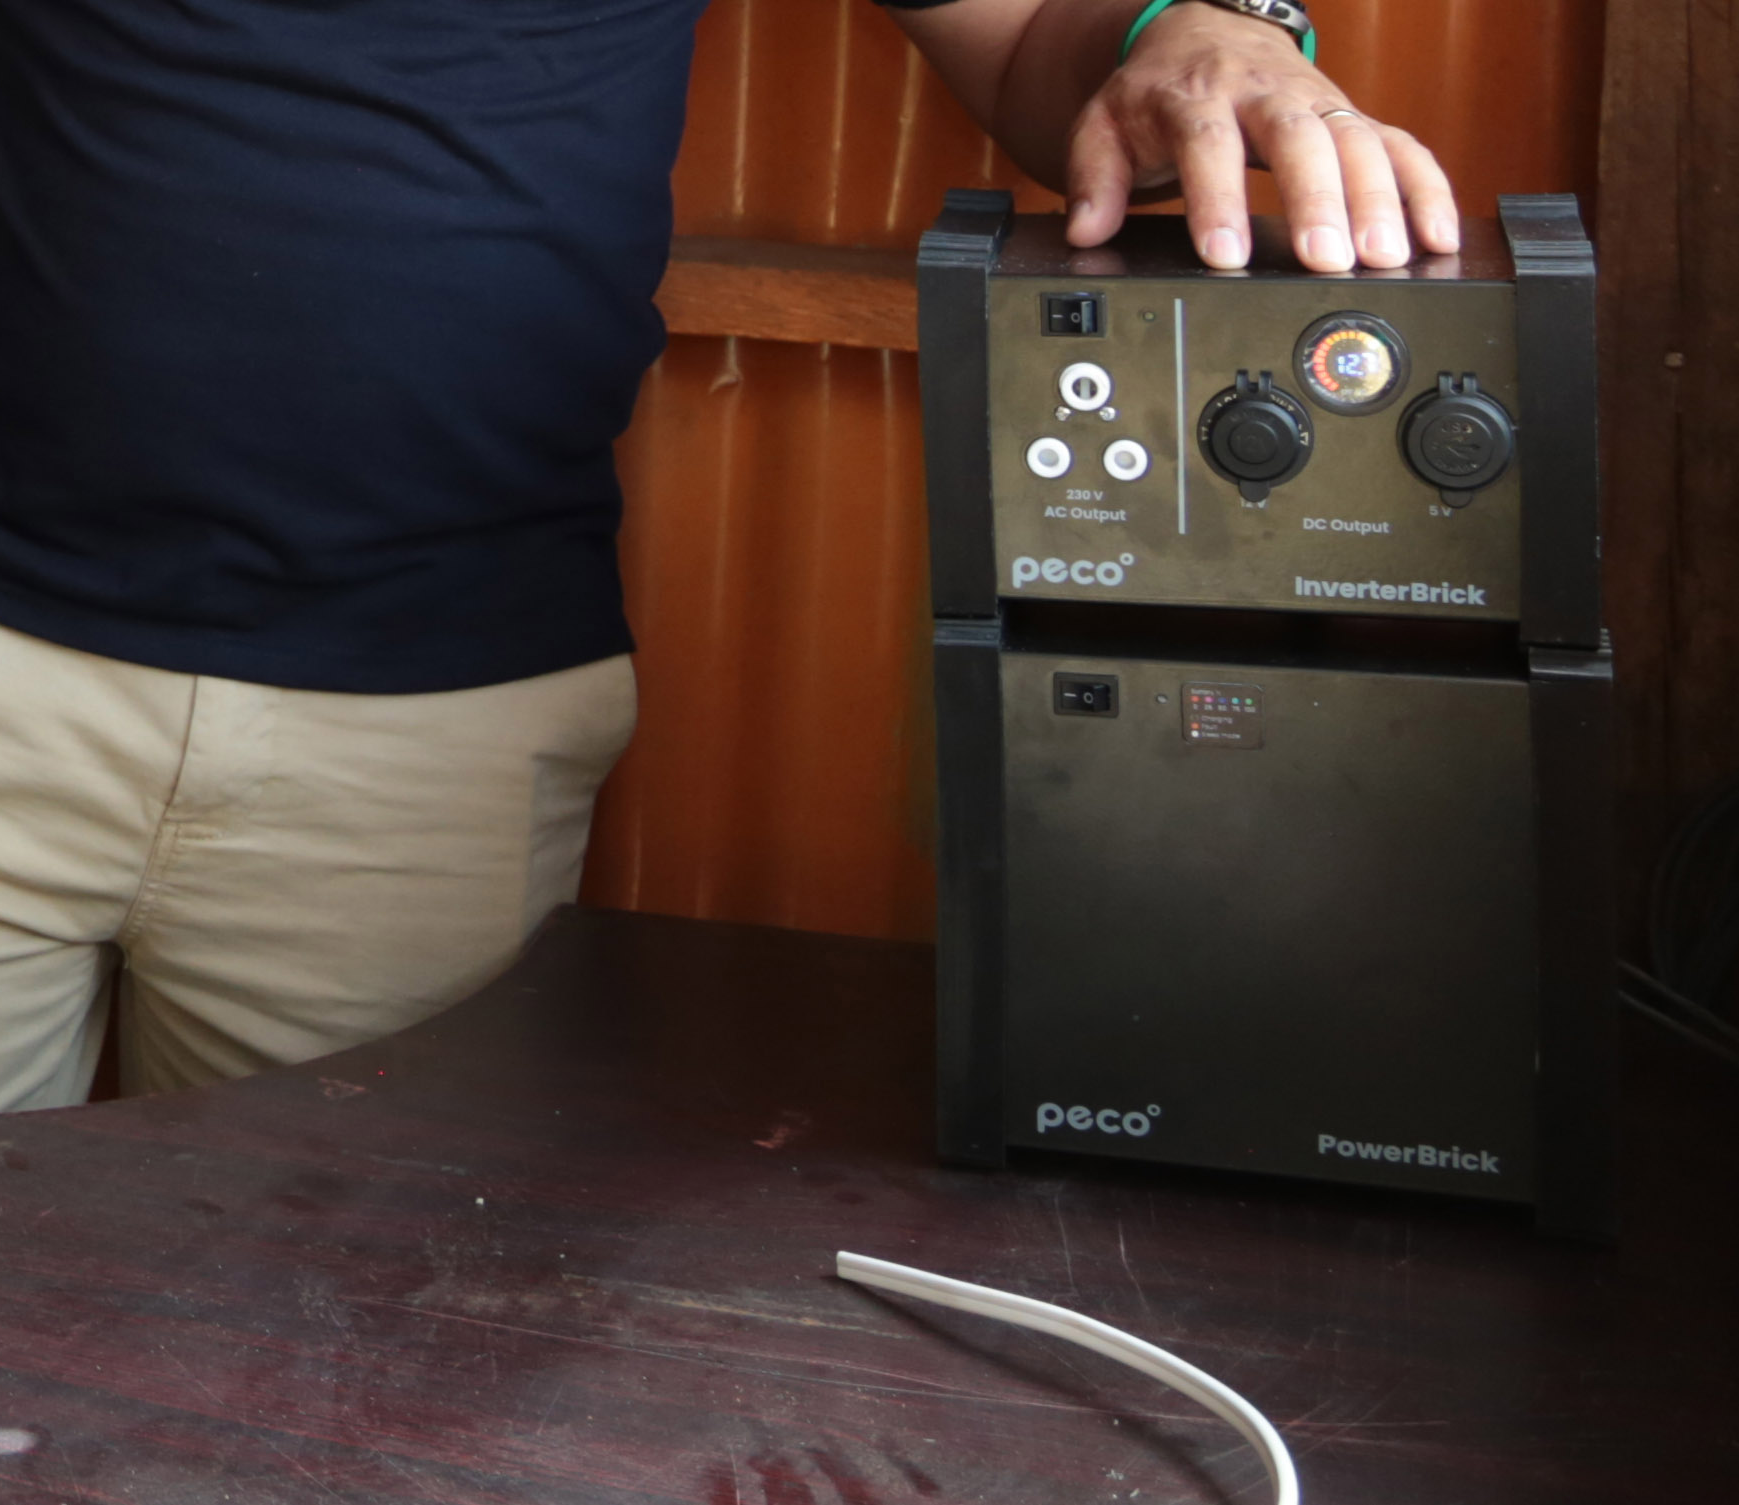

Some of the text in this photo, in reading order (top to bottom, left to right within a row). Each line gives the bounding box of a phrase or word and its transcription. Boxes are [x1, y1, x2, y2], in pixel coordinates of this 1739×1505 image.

[1066, 488, 1104, 501] 230 V
[1044, 506, 1127, 523] AC Output
[1429, 505, 1453, 517] 5 V
[1302, 518, 1390, 535] DC Output
[1295, 576, 1487, 606] InverterBrick
[1318, 1133, 1500, 1174] PowerBrick
